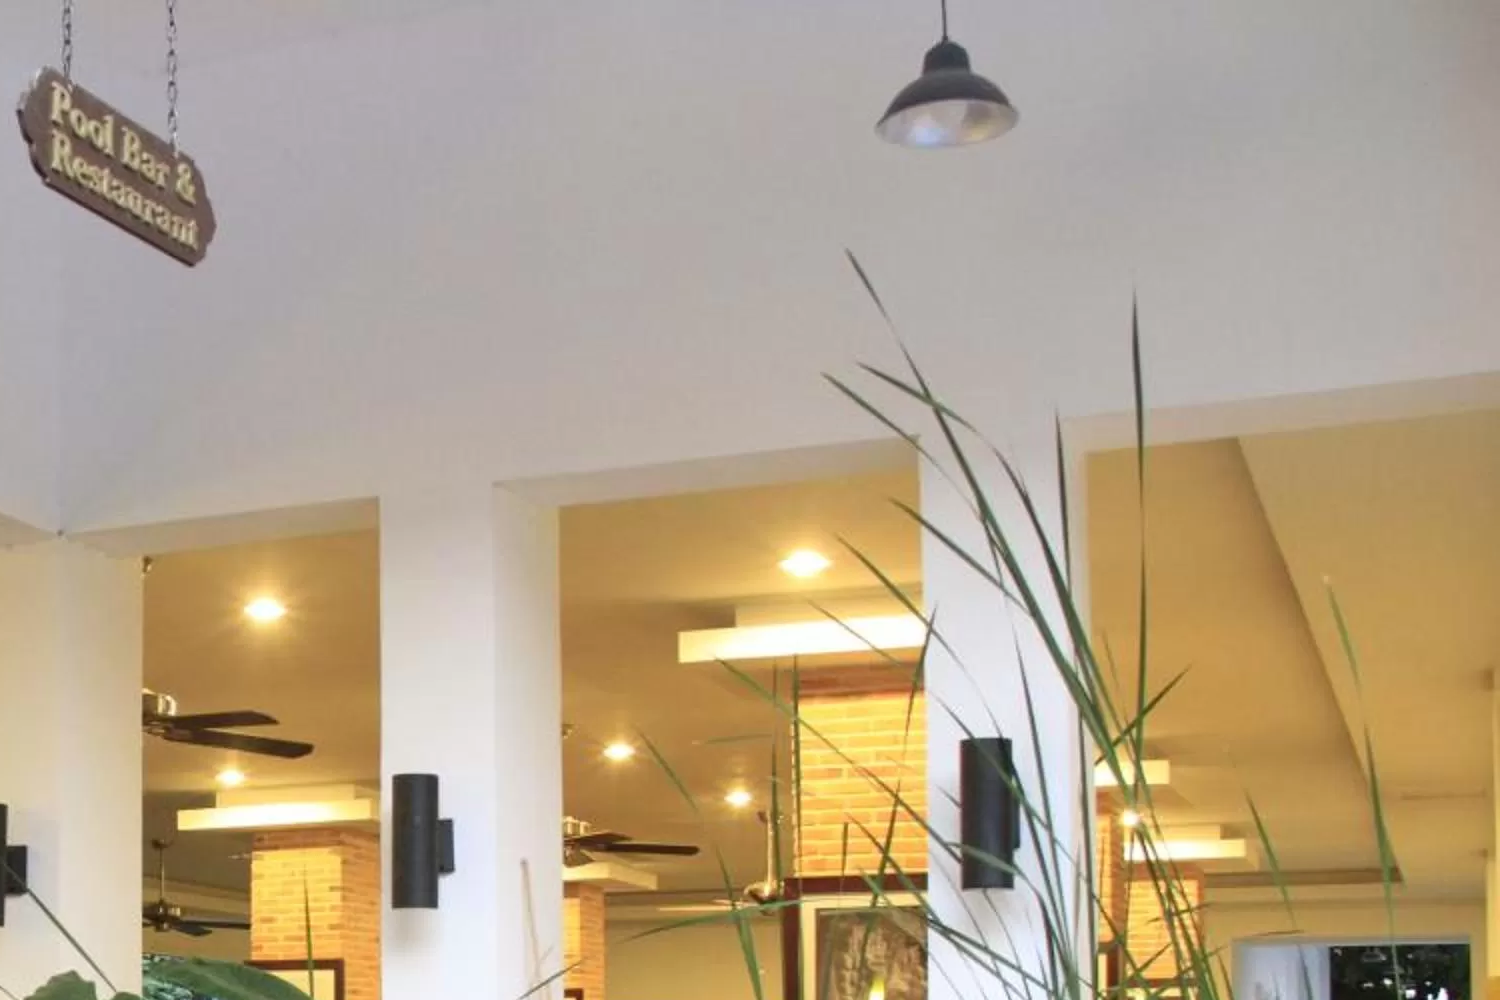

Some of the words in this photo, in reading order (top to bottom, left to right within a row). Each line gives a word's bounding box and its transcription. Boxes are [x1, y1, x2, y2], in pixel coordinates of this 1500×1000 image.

[51, 81, 115, 158] Pool
[120, 126, 171, 189] Bar
[175, 161, 197, 206] &
[51, 127, 199, 251] Restaurant
